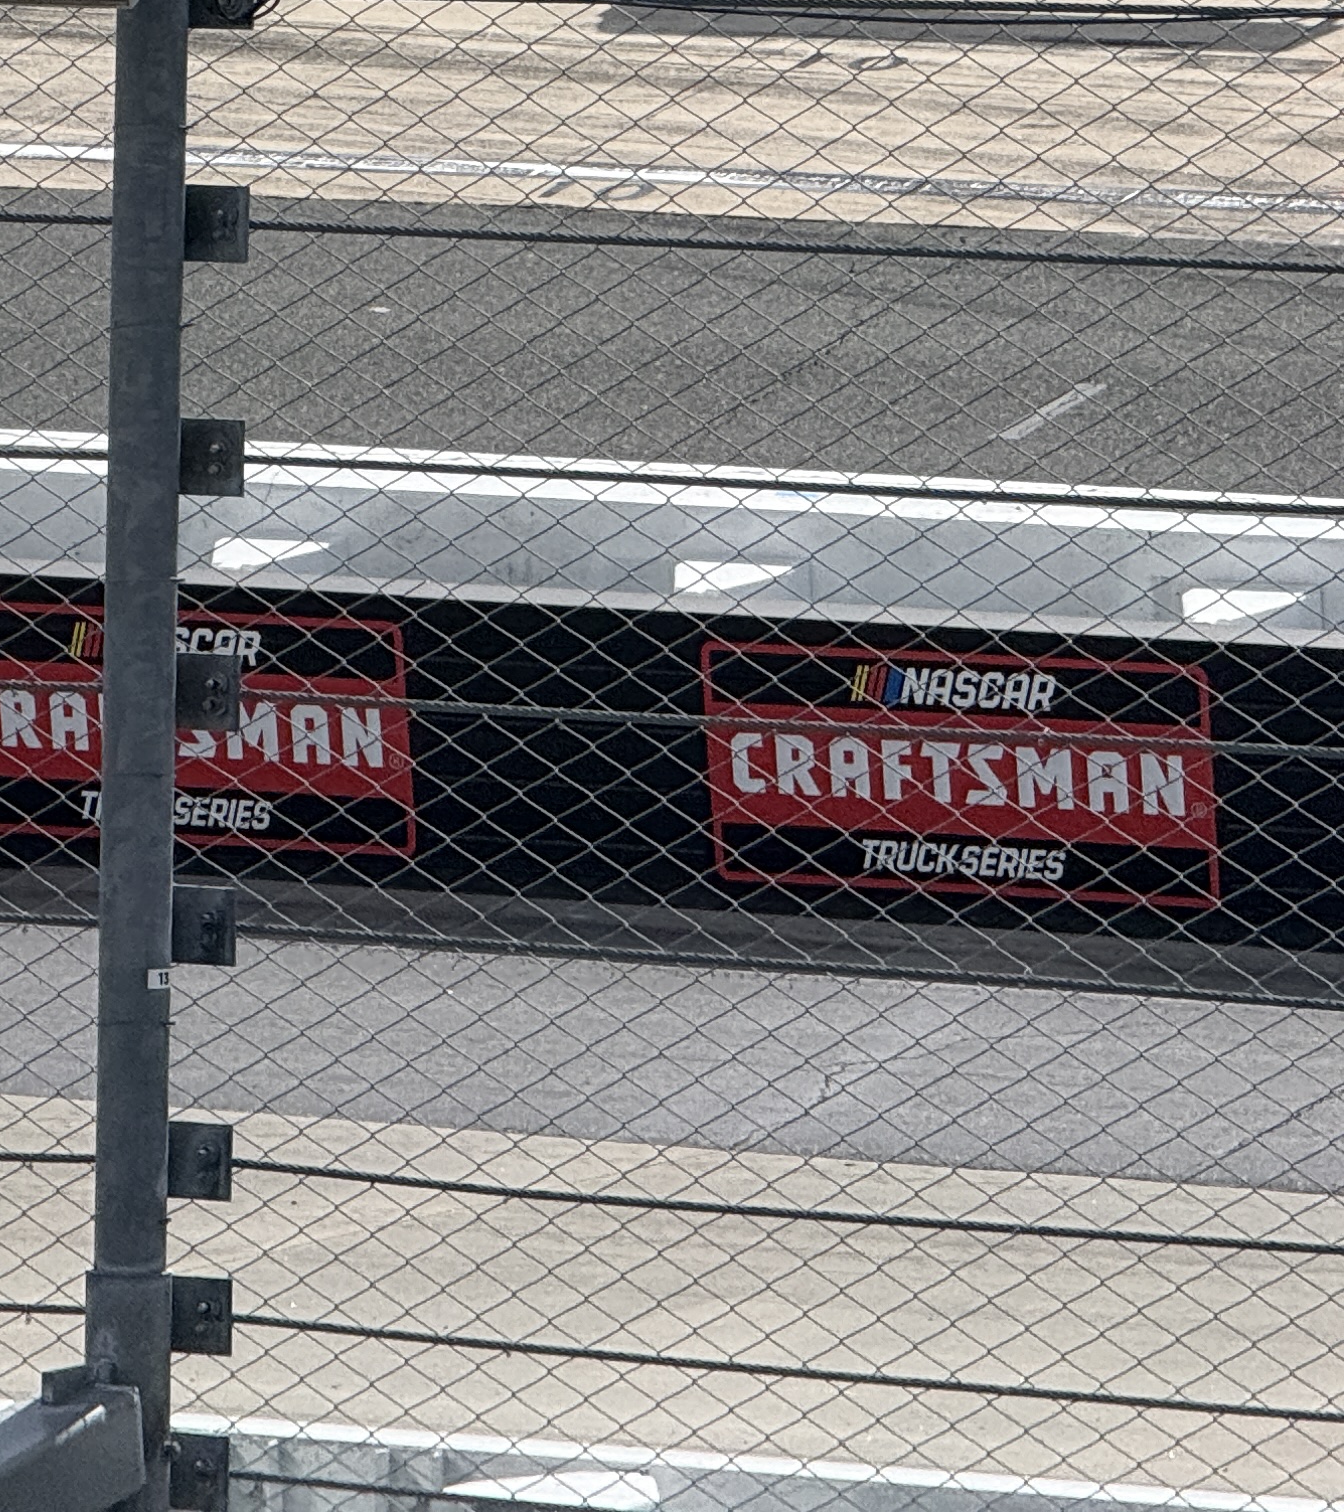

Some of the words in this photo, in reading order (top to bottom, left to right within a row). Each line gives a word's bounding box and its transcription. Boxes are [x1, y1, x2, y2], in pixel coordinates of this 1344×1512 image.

[175, 627, 261, 666] SCAR
[902, 668, 1056, 711] NASCAR
[730, 732, 1185, 816] CRAFTSMAN
[173, 797, 272, 830] SERIES
[862, 839, 963, 874] TRUCK
[960, 844, 1067, 881] SERIES
[158, 972, 169, 986] 13
